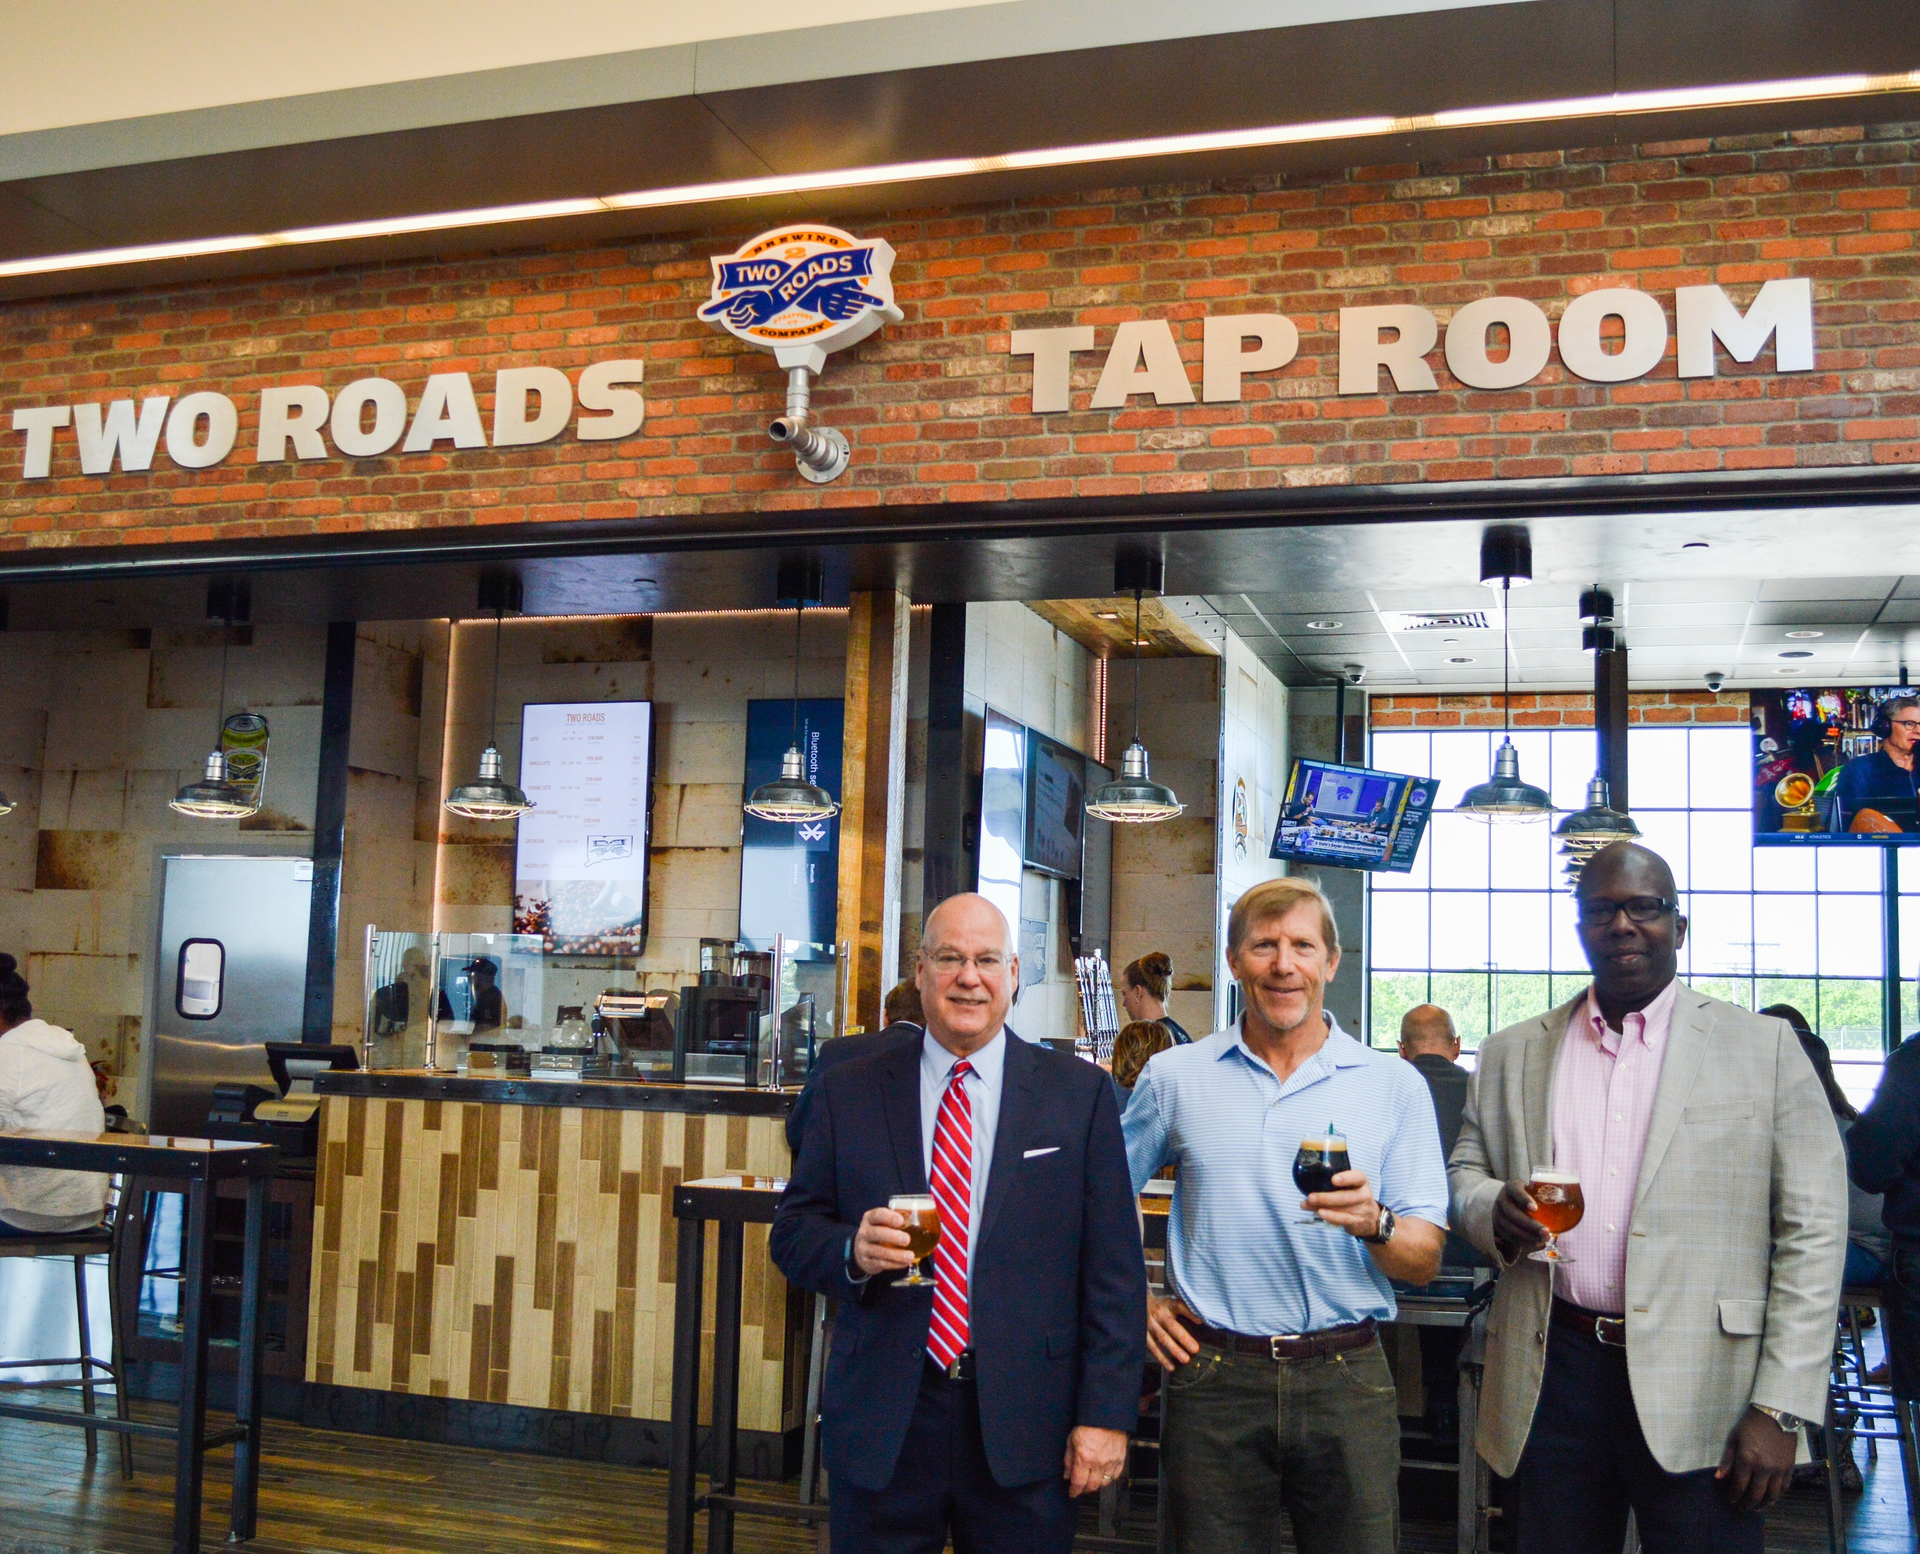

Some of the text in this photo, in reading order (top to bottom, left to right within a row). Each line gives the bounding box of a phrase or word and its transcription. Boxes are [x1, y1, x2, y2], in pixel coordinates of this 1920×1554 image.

[752, 233, 840, 254] BREWING
[736, 255, 853, 302] TWO ROADS
[758, 322, 826, 338] COMPANY
[1010, 277, 1815, 413] TAP ROOM
[12, 359, 645, 479] TWO ROADS
[566, 712, 606, 722] TWO ROADS
[810, 731, 820, 772] Bluetooth
